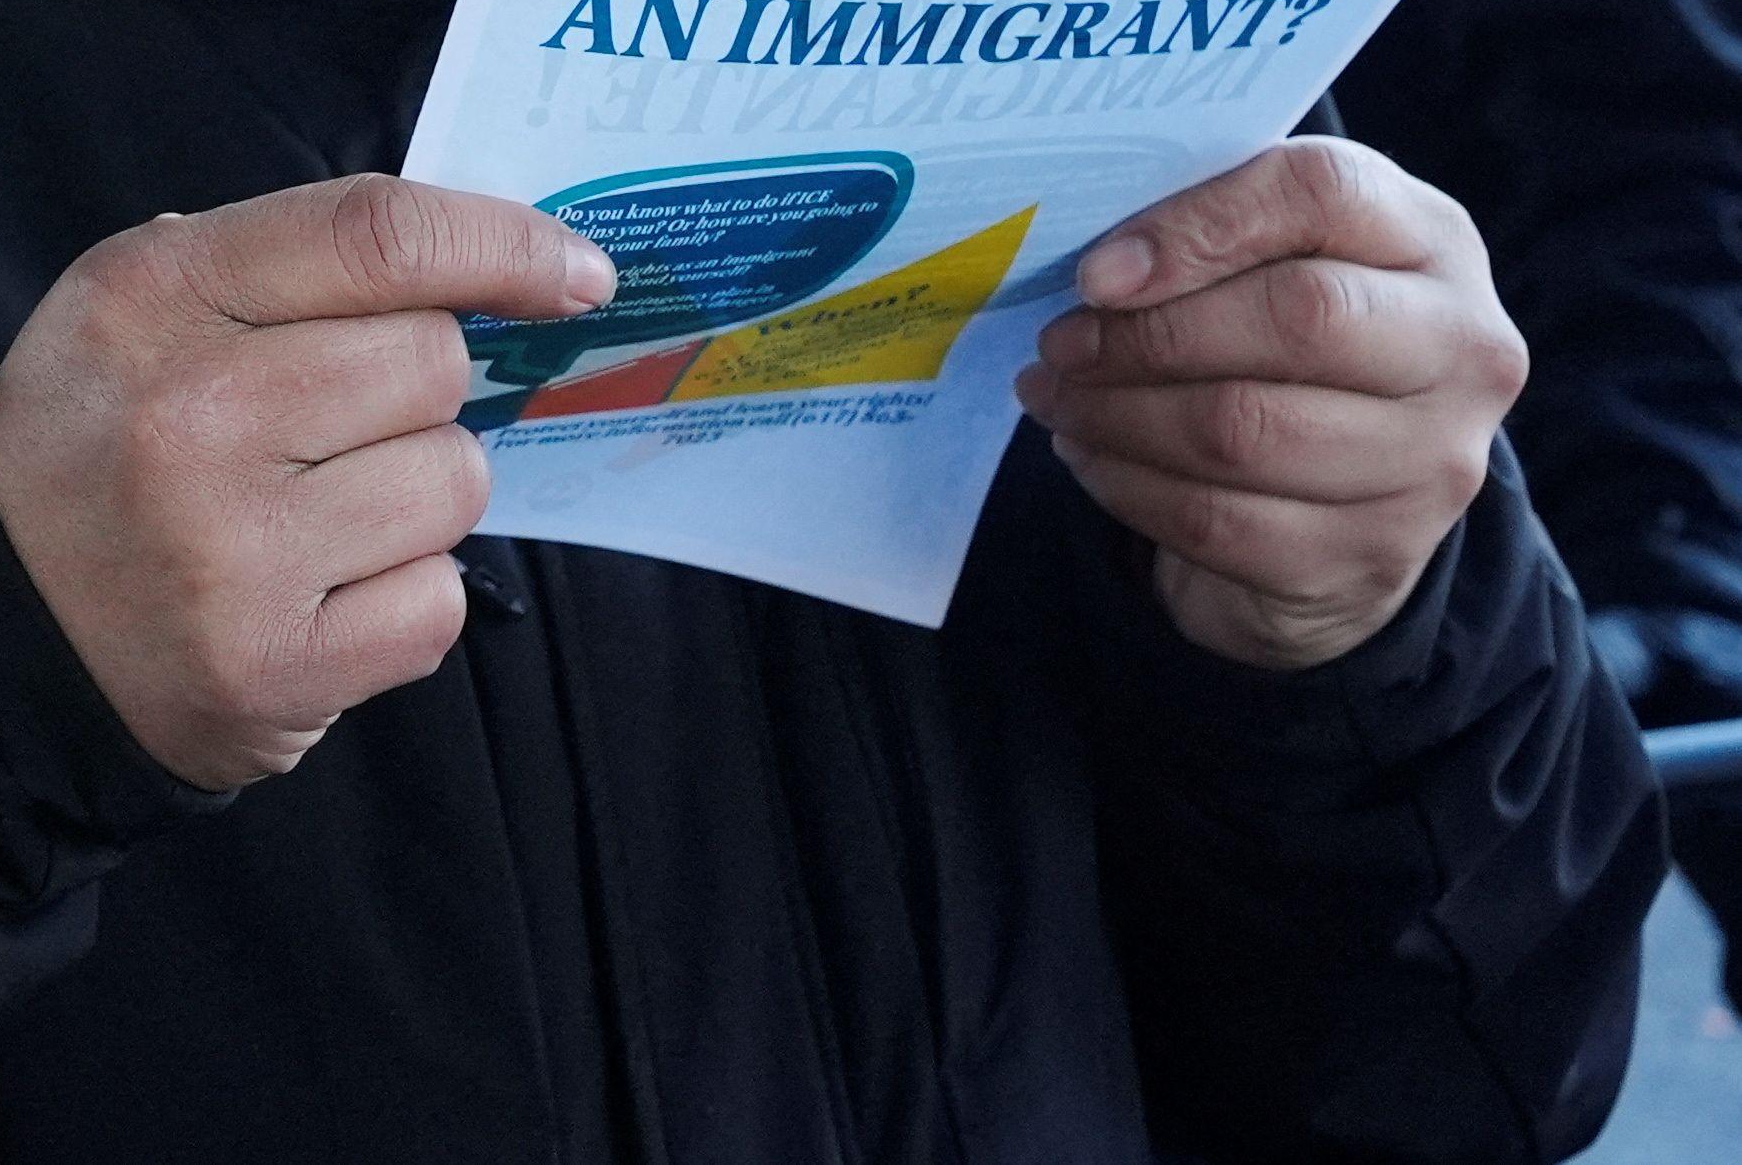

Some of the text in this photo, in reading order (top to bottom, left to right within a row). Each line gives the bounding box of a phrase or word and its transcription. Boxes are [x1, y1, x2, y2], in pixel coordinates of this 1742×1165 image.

[555, 206, 584, 222] Do
[583, 208, 624, 226] you
[626, 203, 682, 220] know
[684, 198, 731, 215] what
[732, 198, 752, 211] to
[753, 194, 778, 210] do
[796, 188, 833, 206] ICE
[615, 220, 668, 241] you?
[667, 218, 695, 233] Or
[694, 215, 733, 230] how
[736, 212, 769, 226] are
[766, 210, 806, 226] you
[803, 202, 858, 222] going
[859, 202, 879, 213] to
[607, 238, 654, 254] your
[652, 229, 727, 250] family?
